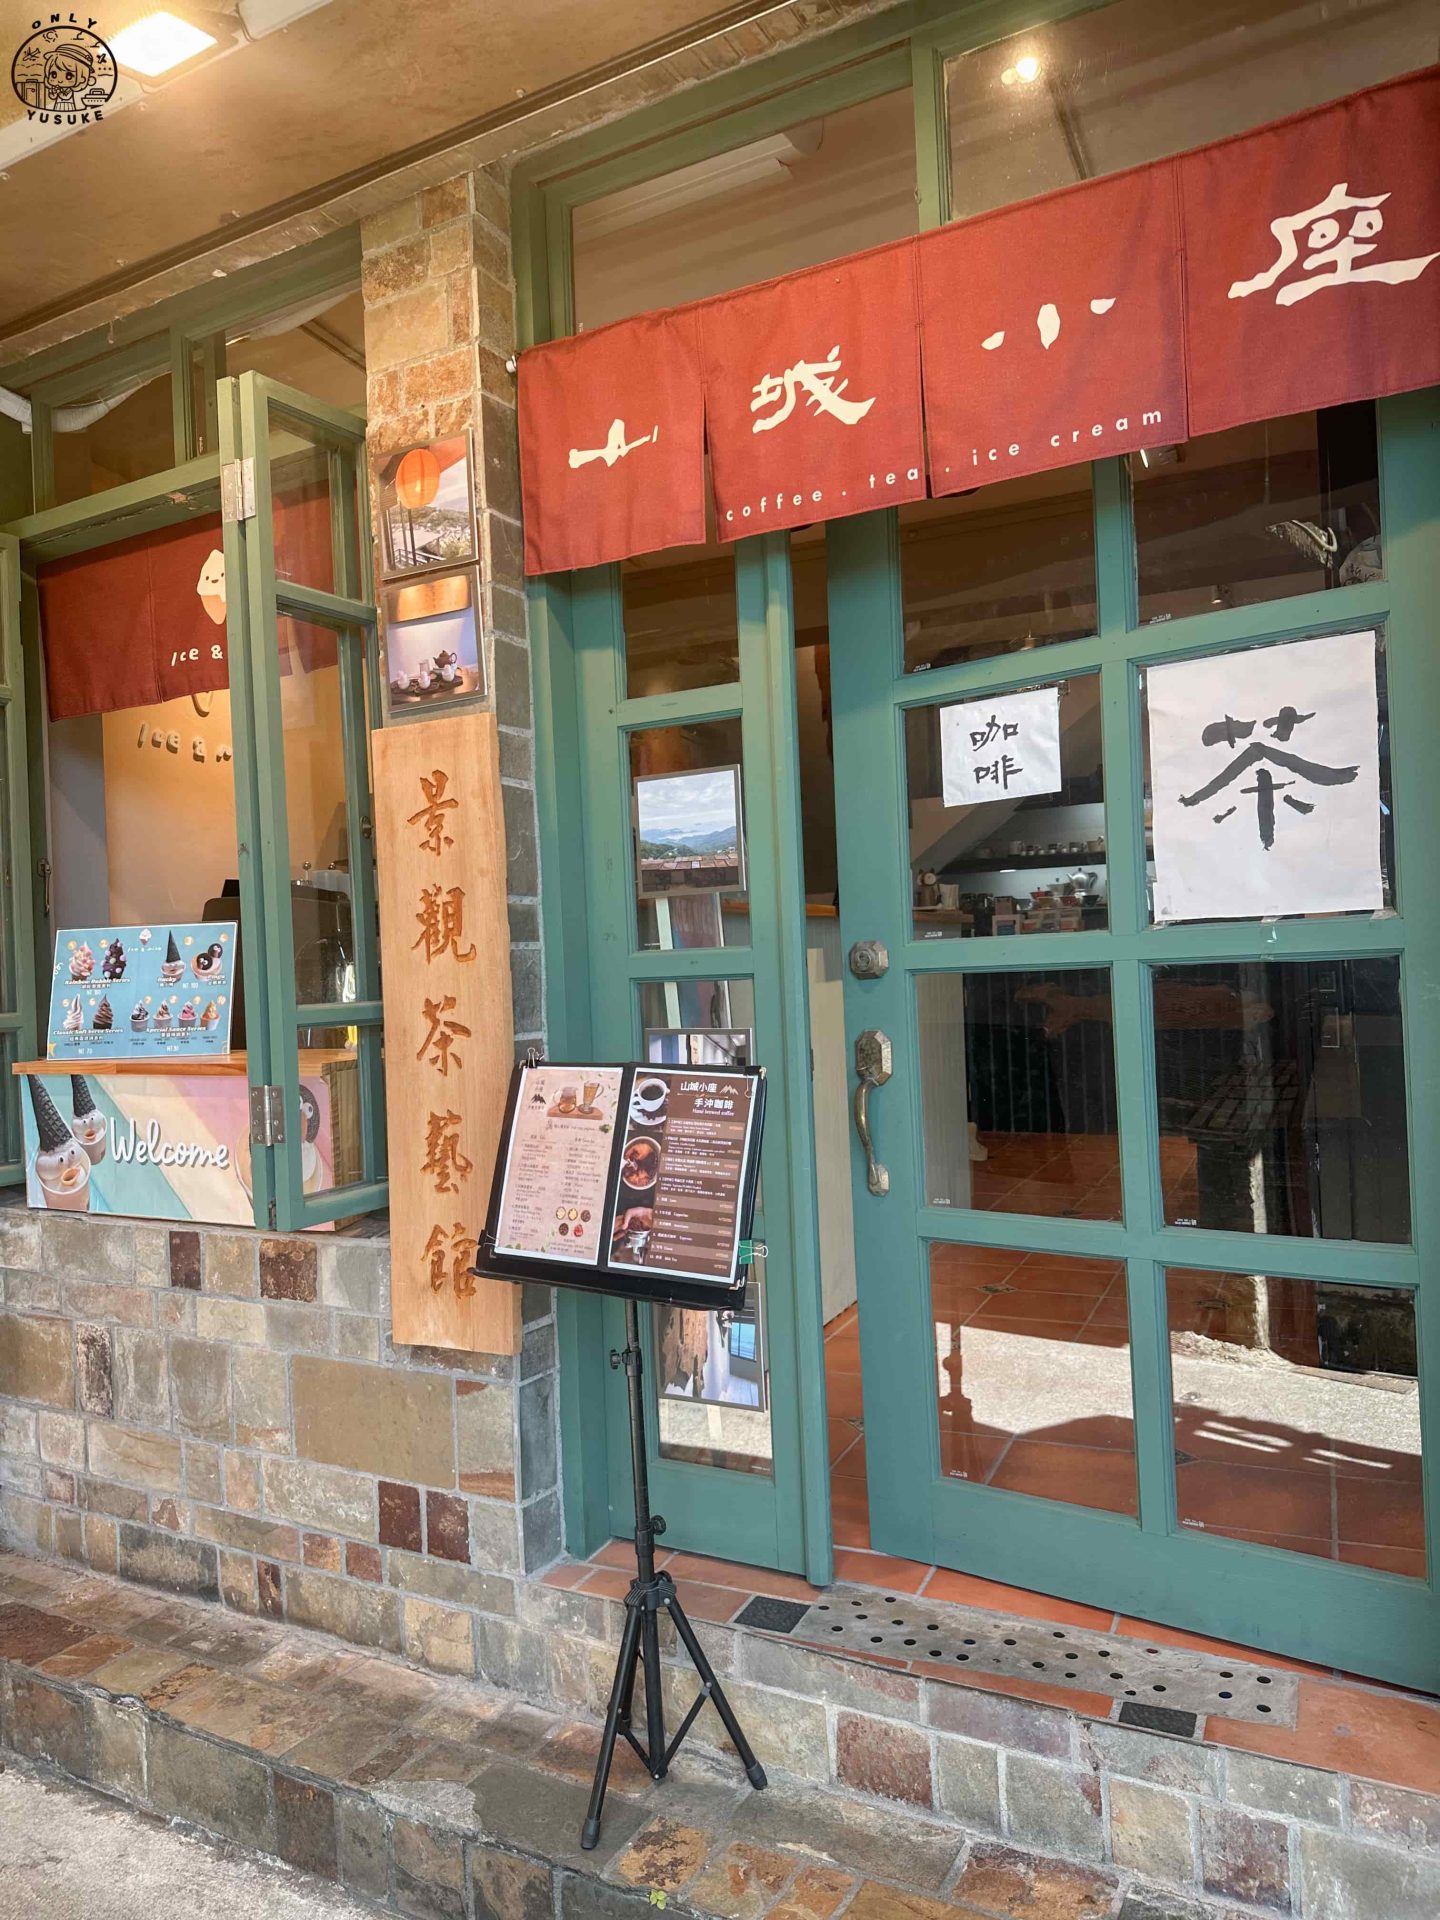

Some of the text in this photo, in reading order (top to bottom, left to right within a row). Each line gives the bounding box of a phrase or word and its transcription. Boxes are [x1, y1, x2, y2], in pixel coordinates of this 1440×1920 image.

[726, 410, 1162, 521] coffee tea ice cream
[171, 644, 223, 667] Ice &
[969, 714, 1023, 790] 咖啡
[1177, 706, 1361, 851] 茶
[407, 769, 478, 1299] 景觀茶藝館
[680, 1081, 718, 1093] 山城小座
[110, 1116, 230, 1168] Welcome
